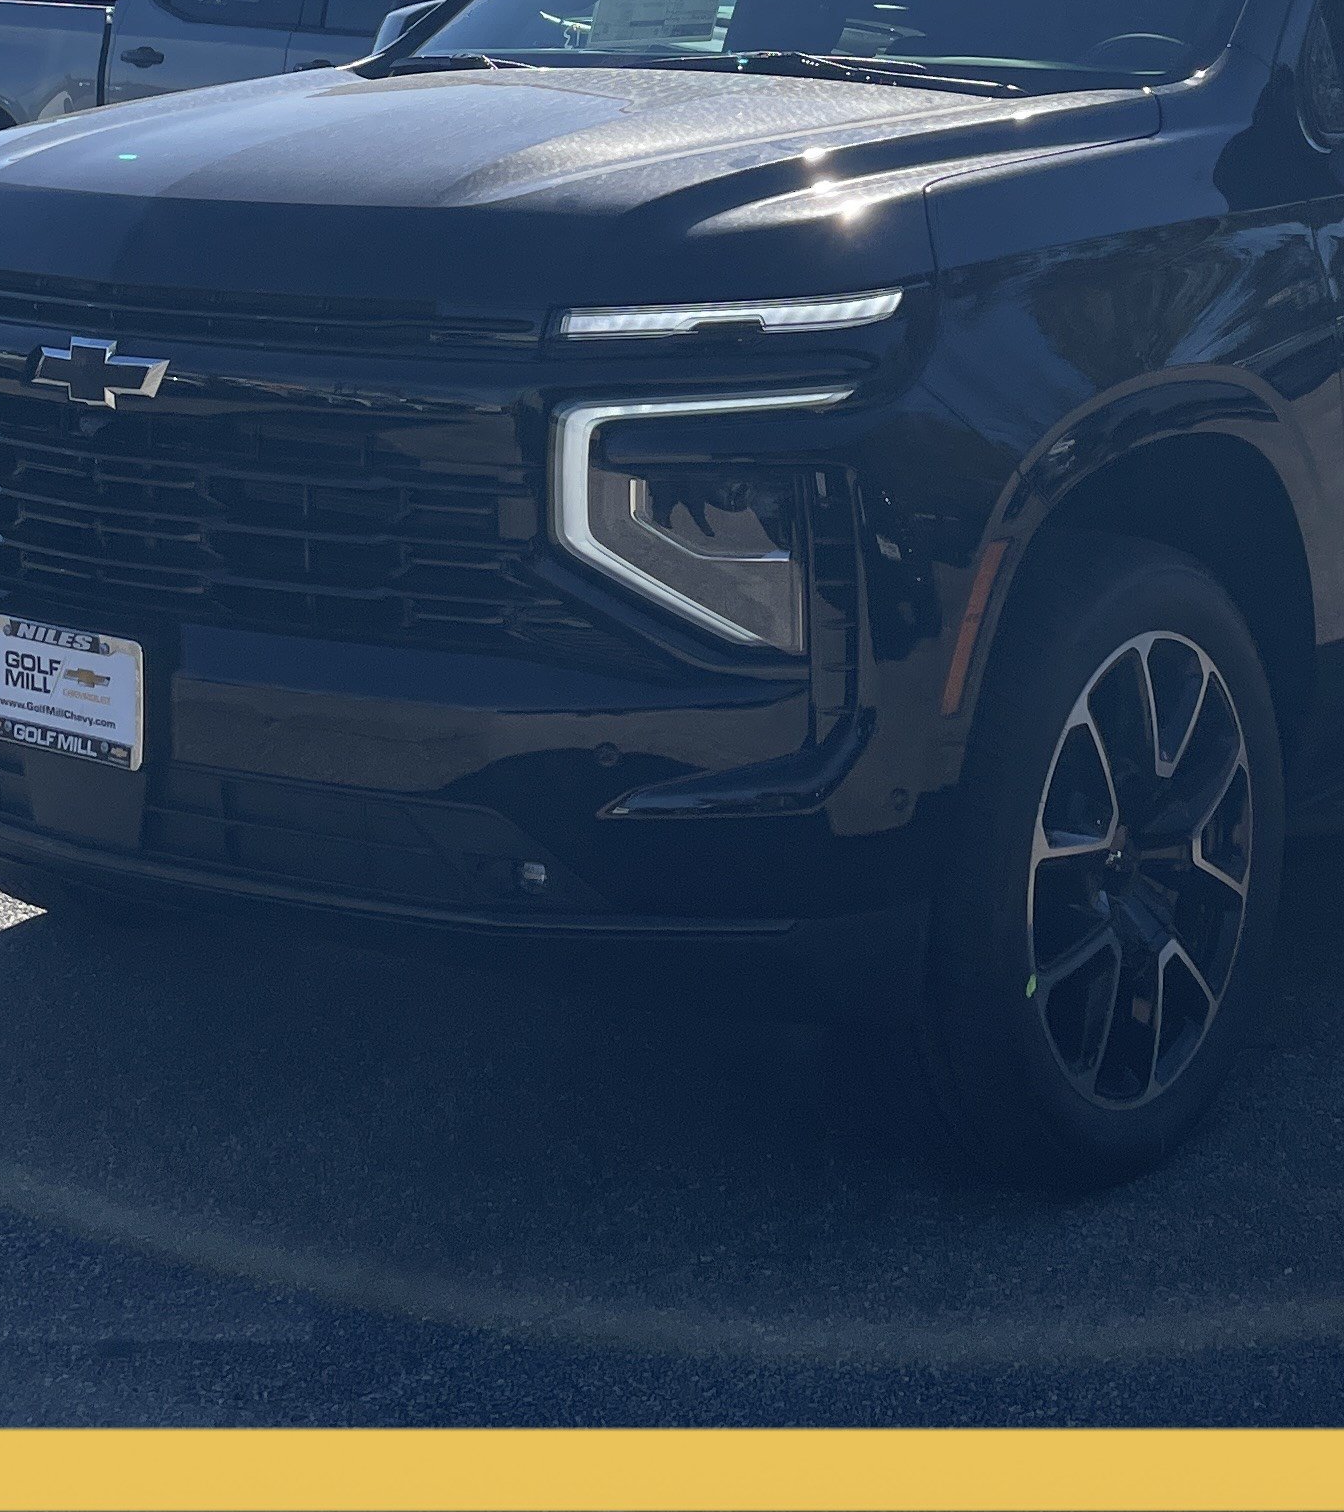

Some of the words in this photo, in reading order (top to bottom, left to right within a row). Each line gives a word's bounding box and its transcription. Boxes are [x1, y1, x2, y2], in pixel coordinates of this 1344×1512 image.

[16, 623, 93, 651] NILES
[5, 650, 61, 676] GOLF
[5, 668, 52, 694] MILL
[13, 723, 56, 747] GOLF
[57, 733, 98, 758] MILL
